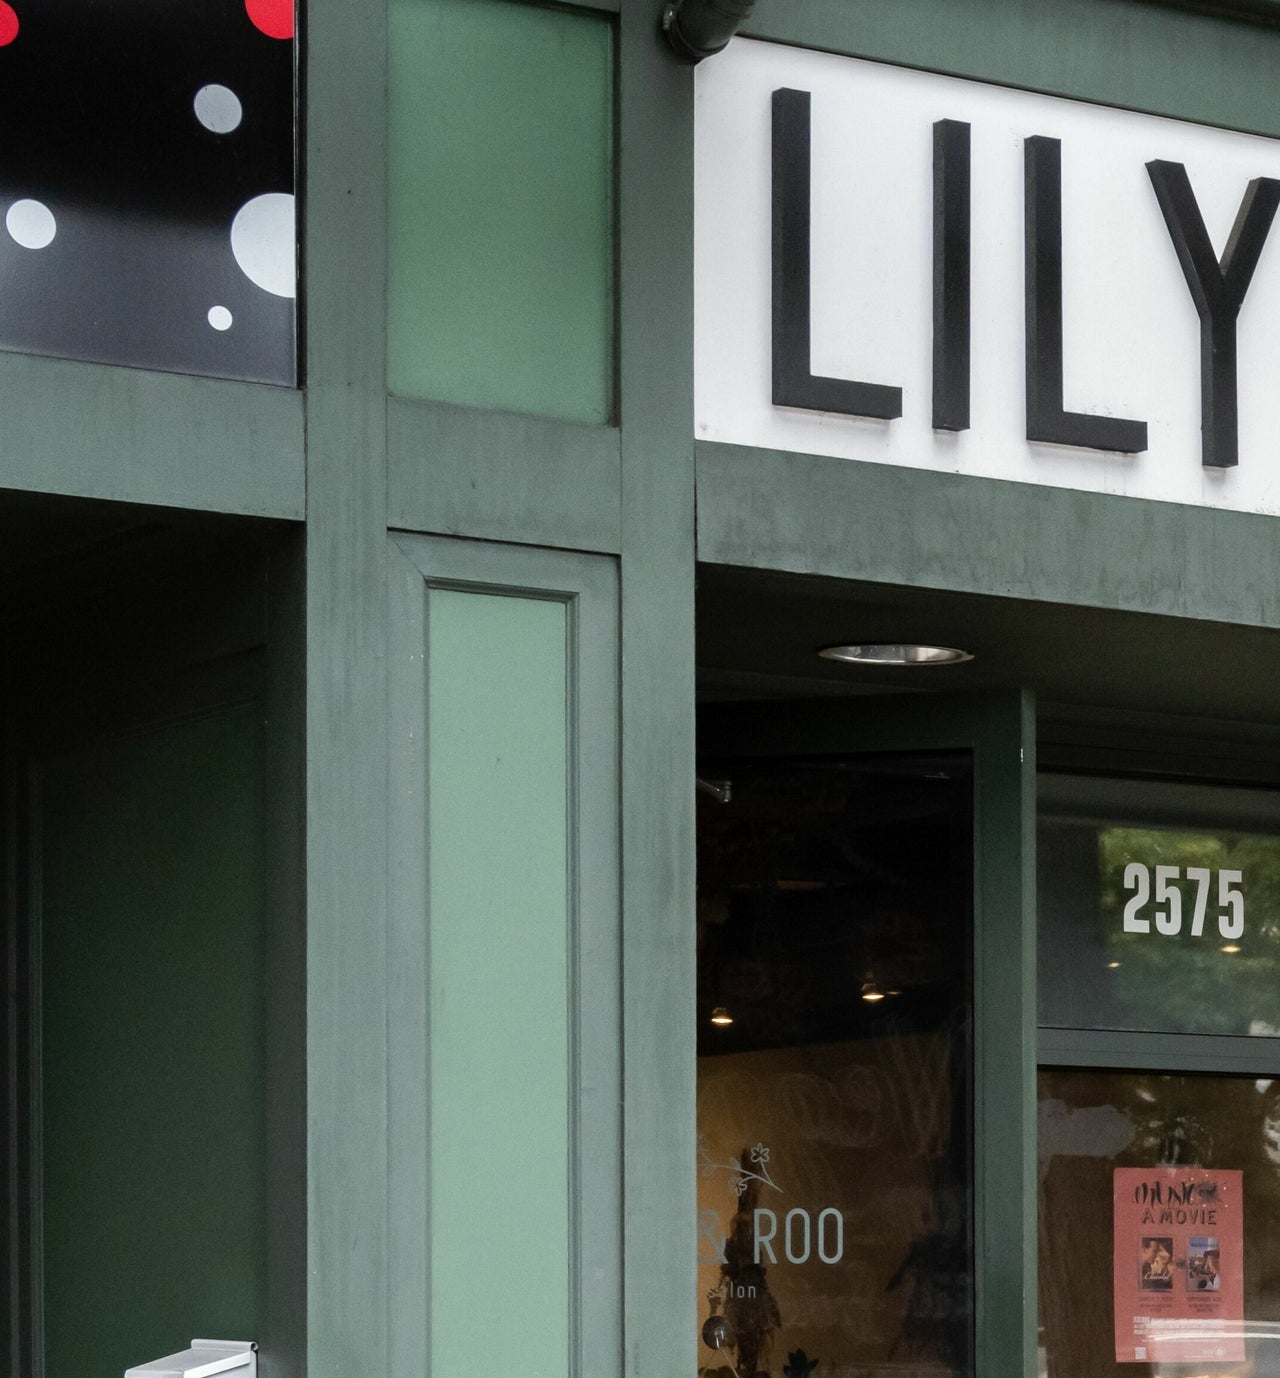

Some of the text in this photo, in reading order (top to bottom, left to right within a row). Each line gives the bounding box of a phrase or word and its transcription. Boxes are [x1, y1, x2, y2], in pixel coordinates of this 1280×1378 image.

[1123, 862, 1245, 939] 2575
[754, 1207, 844, 1264] ROO
[1159, 1208, 1217, 1225] MOVIE
